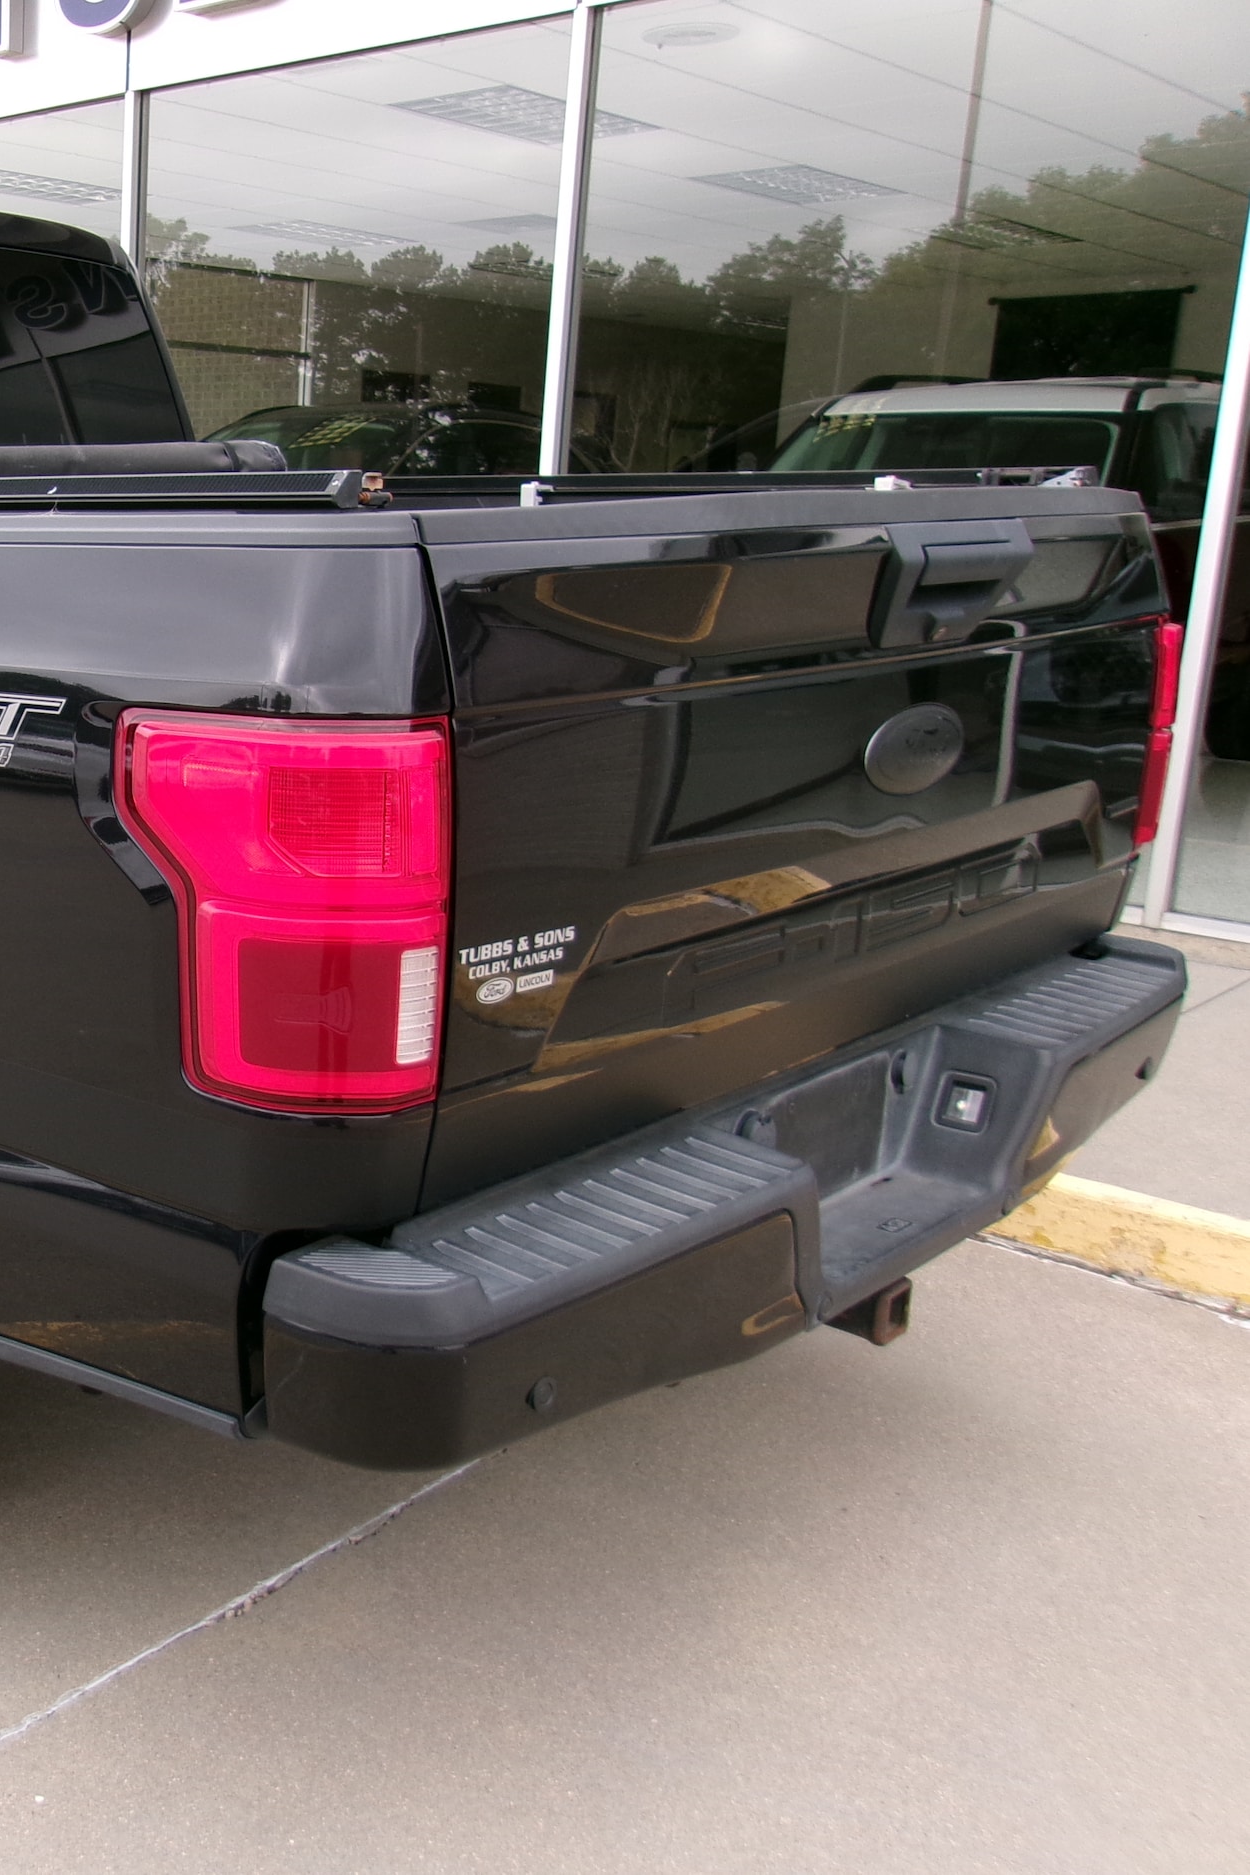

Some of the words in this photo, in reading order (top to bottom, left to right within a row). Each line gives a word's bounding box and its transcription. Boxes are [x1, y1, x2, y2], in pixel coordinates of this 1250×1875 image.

[459, 939, 513, 965] TUBBS
[517, 936, 530, 952] &
[534, 926, 576, 948] SONS
[468, 959, 511, 980] COLBY,
[514, 947, 564, 970] KANSAS
[518, 972, 552, 989] LINCOLN
